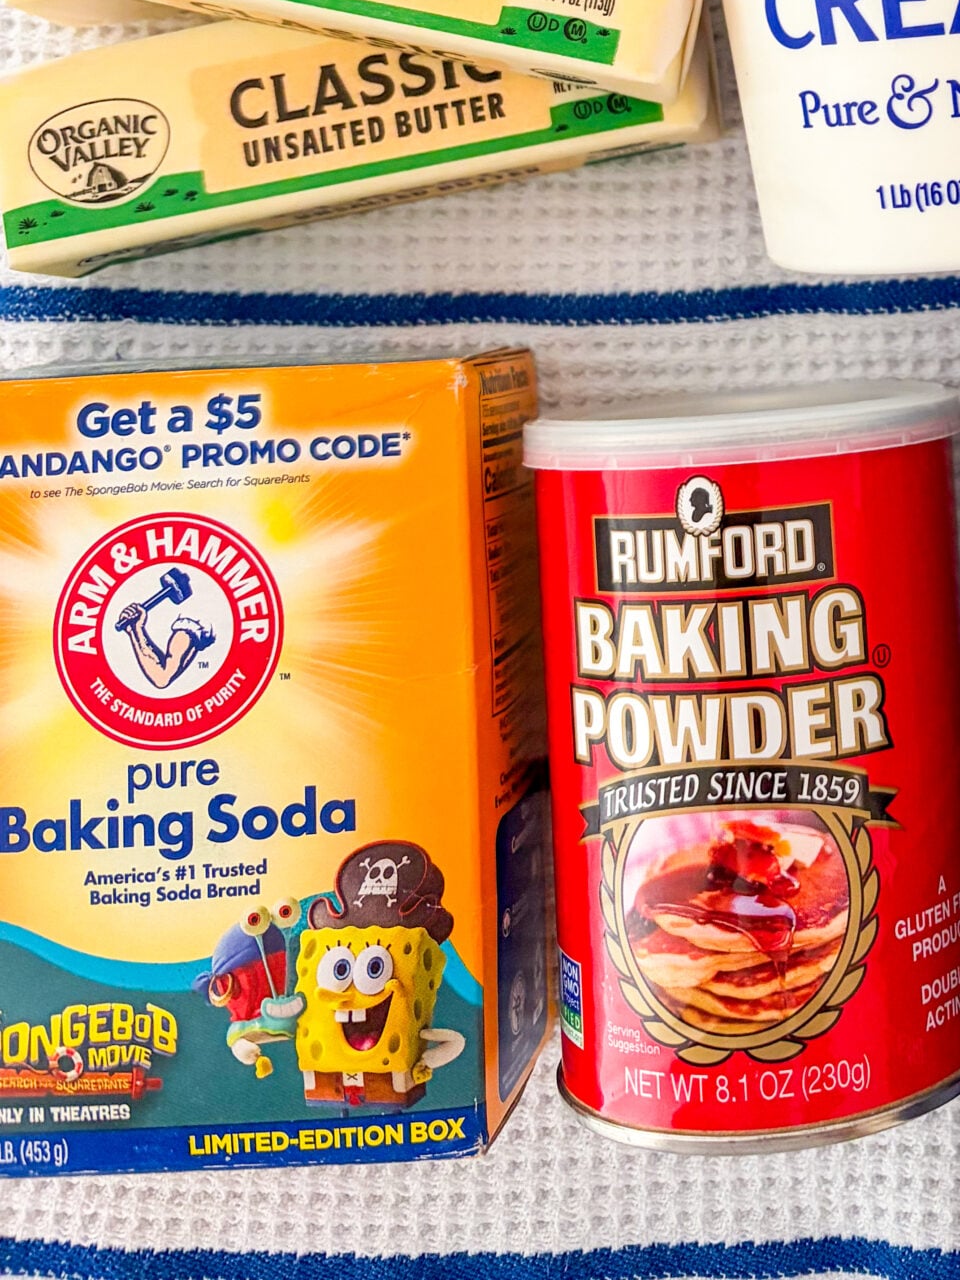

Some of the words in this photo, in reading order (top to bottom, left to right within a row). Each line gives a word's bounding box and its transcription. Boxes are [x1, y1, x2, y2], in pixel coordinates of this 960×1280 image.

[799, 89, 879, 130] Pure
[886, 74, 939, 130] &
[36, 113, 157, 157] ORGANIC
[243, 117, 387, 168] UNSALTED
[396, 93, 505, 139] BUTTER
[876, 186, 886, 209] 1
[890, 184, 911, 208] Lb
[915, 181, 943, 212] (16
[77, 400, 157, 438] Get
[168, 404, 193, 432] a
[206, 393, 262, 435] $5
[30, 490, 42, 499] to
[43, 489, 62, 499] see
[64, 486, 84, 497] The
[86, 483, 148, 497] SpongeBob
[150, 480, 185, 492] Movie:
[187, 476, 224, 489] Search
[225, 476, 242, 488] for
[244, 472, 311, 488] SquarePants
[610, 519, 816, 584] RUMFORD
[67, 564, 116, 655] ARM
[110, 542, 144, 574] &
[145, 526, 269, 644] HAMMER
[576, 586, 868, 678] BAKING
[89, 676, 111, 705] THE
[110, 698, 183, 728] STANDARD
[186, 706, 204, 723] OF
[206, 668, 247, 713] PURITY
[572, 673, 894, 769] POWDER
[127, 758, 220, 804] pure
[604, 773, 699, 817] TRUSTED
[707, 771, 788, 801] SINCE
[798, 772, 860, 804] 1859
[0, 798, 193, 860] Baking
[206, 785, 357, 843] Soda
[83, 866, 170, 887] America's
[174, 864, 197, 881] #1
[201, 858, 268, 879] Trusted
[90, 888, 151, 907] Baking
[156, 885, 201, 902] Soda
[207, 879, 261, 899] Brand
[938, 875, 947, 895] A
[895, 900, 950, 940] GLUTEN
[607, 1021, 641, 1041] Serving
[608, 1035, 660, 1055] Suggestion
[88, 1045, 152, 1069] MOVIE
[624, 1067, 666, 1099] NET
[671, 1073, 709, 1102] WT
[716, 1075, 748, 1104] 8.1
[759, 1070, 795, 1098] OZ
[801, 1054, 871, 1101] (230g)
[189, 1123, 403, 1156] LIMITED-EDITION
[410, 1117, 466, 1144] BOX
